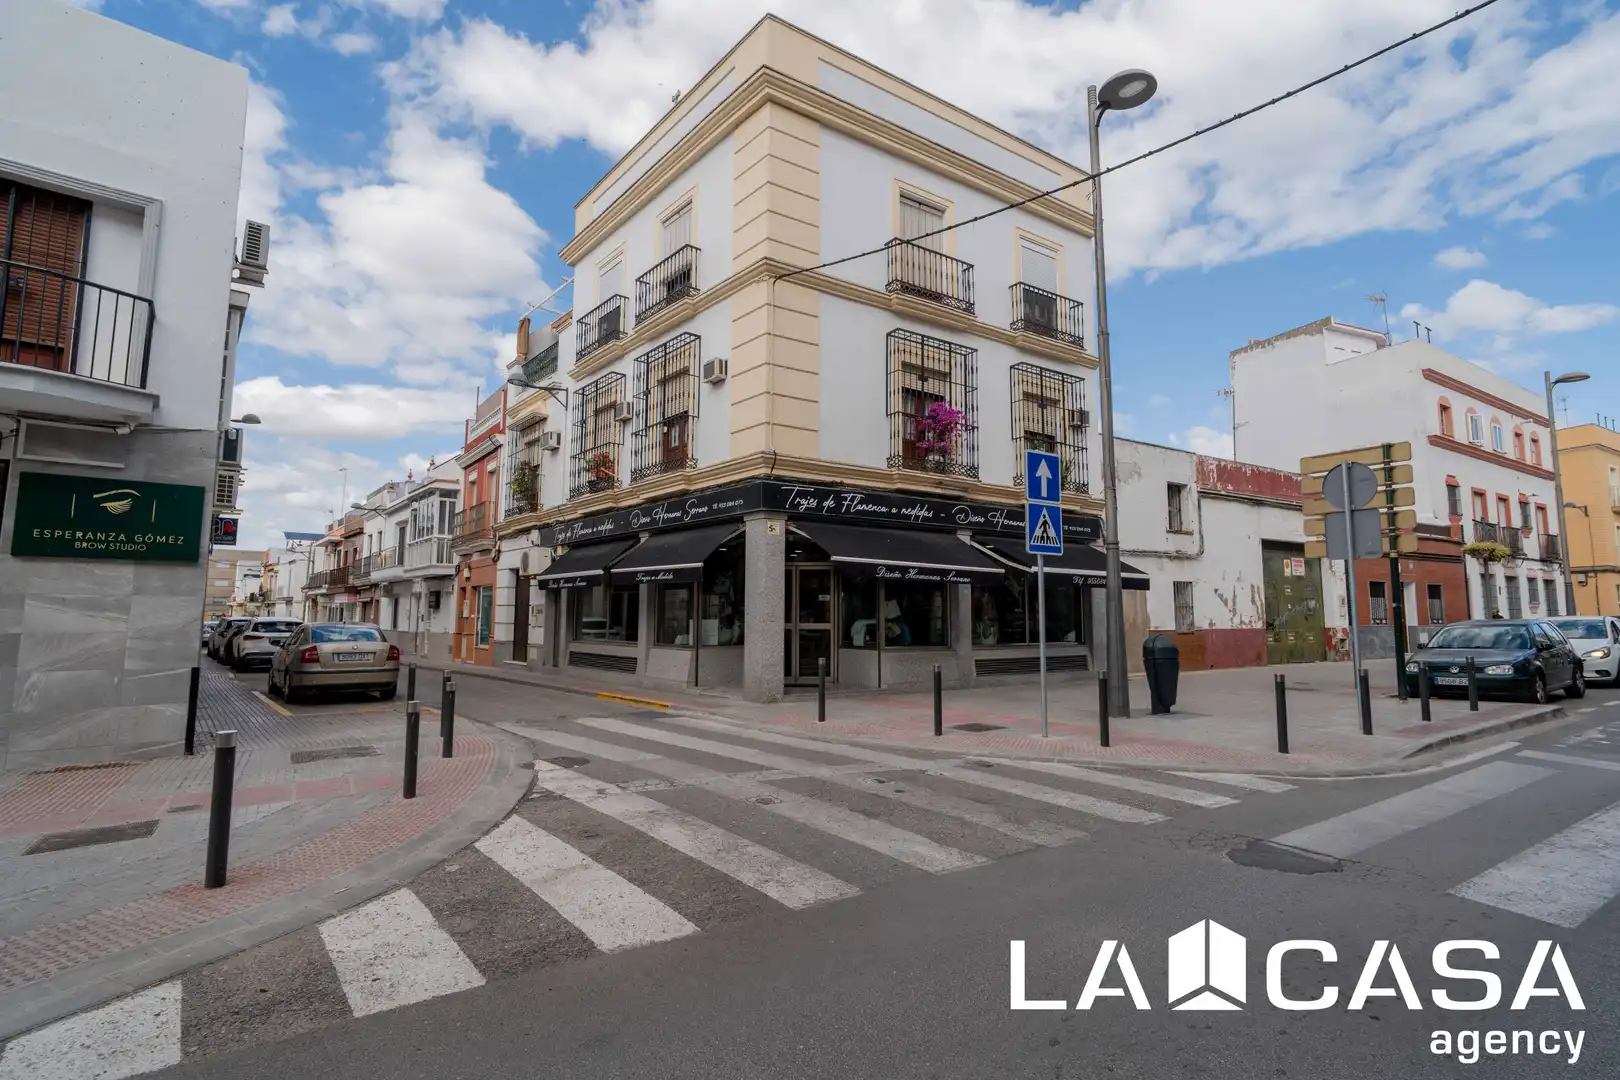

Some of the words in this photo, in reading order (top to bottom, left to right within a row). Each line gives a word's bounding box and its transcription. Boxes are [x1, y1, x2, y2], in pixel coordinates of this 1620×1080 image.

[781, 486, 818, 512] Trajes
[822, 494, 836, 514] de
[840, 493, 889, 513] Flamenca
[952, 505, 985, 524] Diseño
[33, 529, 126, 542] ESPERANZA
[134, 533, 184, 545] GÓMEZ
[74, 541, 107, 550] BROW
[109, 542, 147, 551] STUDIO
[876, 566, 902, 578] Diseño
[905, 568, 940, 580] Hermanas
[943, 571, 971, 582] Serrano
